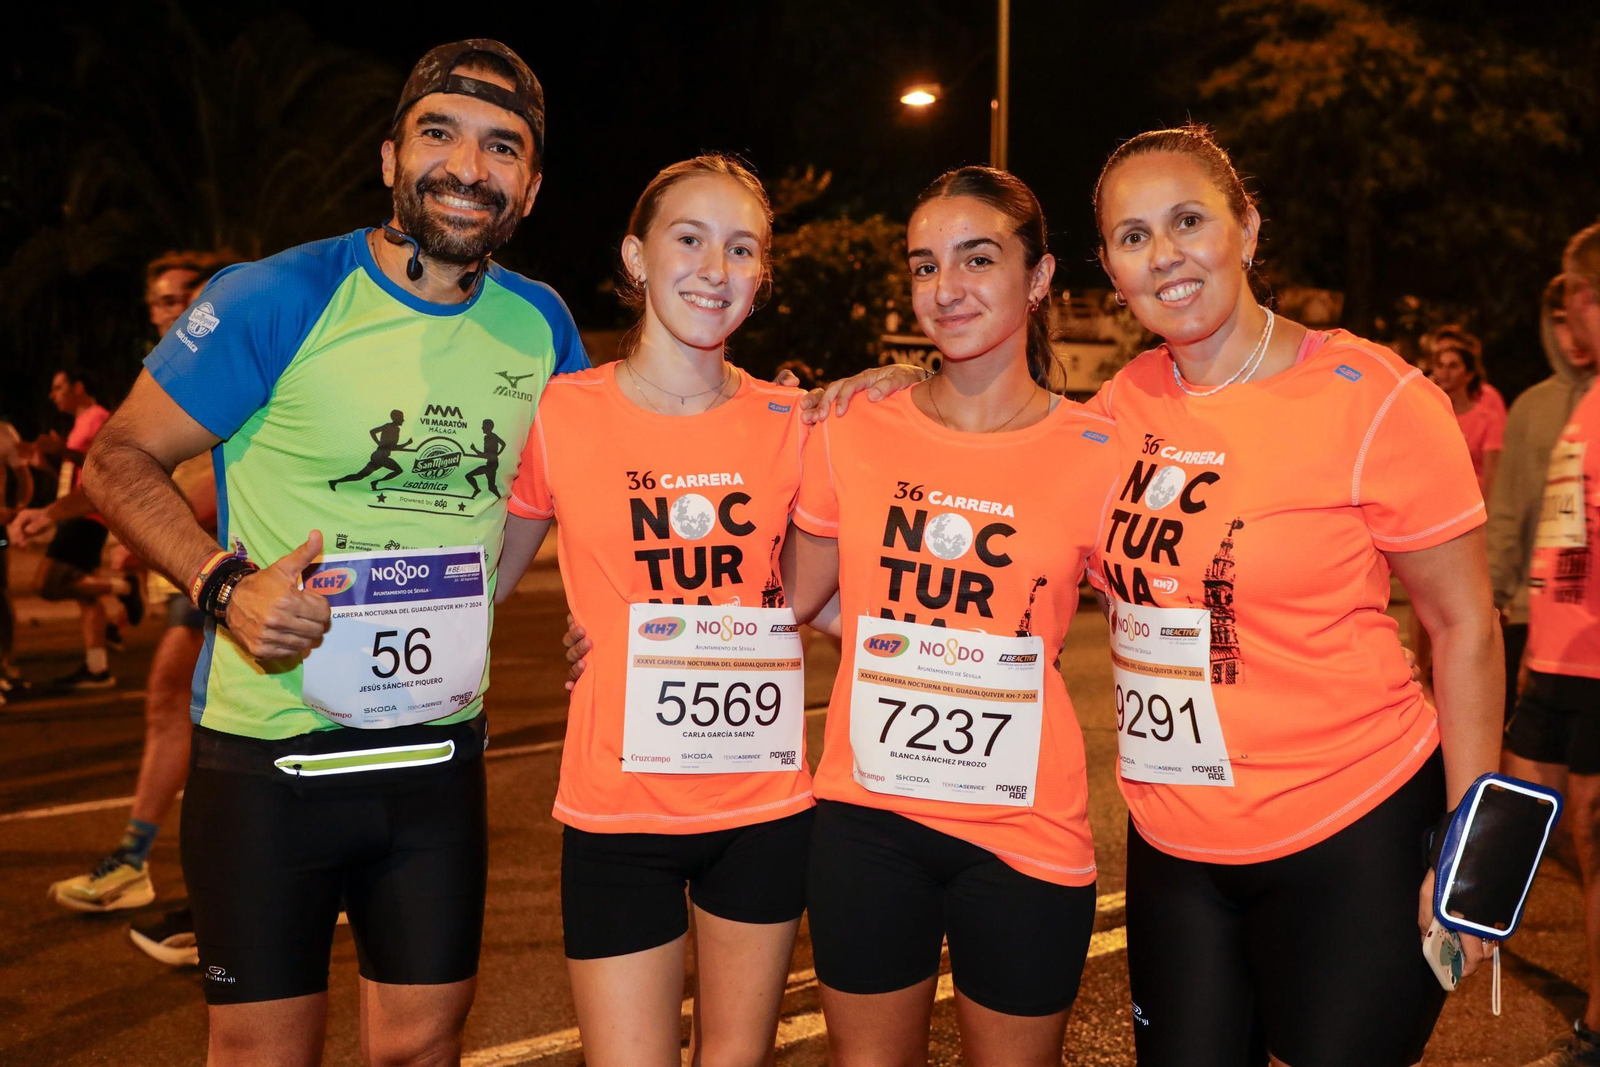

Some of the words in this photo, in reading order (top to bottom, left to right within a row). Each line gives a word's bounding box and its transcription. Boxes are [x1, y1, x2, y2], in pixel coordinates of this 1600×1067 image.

[493, 385, 533, 403] MIZUNO
[428, 427, 457, 435] MÁLAGA
[431, 418, 467, 429] MARATÓN
[1142, 433, 1165, 455] 36
[1160, 446, 1226, 466] CARRERA
[626, 471, 656, 490] 36
[660, 472, 744, 489] CARRERA
[894, 481, 924, 501] 36
[928, 490, 1015, 518] CARRERA
[1105, 508, 1184, 567] TUR
[634, 545, 744, 590] TUR
[880, 555, 994, 619] TUR
[332, 611, 363, 619] CARRERA
[364, 608, 398, 617] NOCTURNA
[410, 603, 454, 614] GUADALQUIVIR
[454, 602, 468, 610] KH-7
[371, 627, 432, 679] 56
[733, 661, 776, 669] GUADALQUIVIR
[1137, 664, 1174, 675] GUADALQUIVIR
[1174, 668, 1187, 676] KH-7
[359, 682, 381, 693] JESÚS
[382, 679, 414, 690] SÁNCHEZ
[415, 677, 443, 687] PIQUERO
[860, 672, 878, 680] XXXVI
[879, 675, 906, 685] CARRERA
[907, 680, 941, 691] NOCTURNA
[942, 684, 954, 693] DEL
[955, 687, 1005, 699] GUADALQUIVIR
[450, 691, 473, 704] POWER
[656, 680, 782, 727] 5569
[1116, 683, 1202, 744] 9291
[707, 730, 733, 738] GARCÍA
[878, 697, 1012, 757] 7237
[631, 754, 671, 764] Cruzcampo
[769, 751, 796, 759] POWER
[781, 757, 796, 766] ADE
[890, 751, 920, 762] BLANCA
[921, 754, 956, 766] SÁNCHEZ
[957, 759, 987, 768] PEROZO
[1191, 765, 1224, 773] POWER
[995, 784, 1027, 793] POWER
[1009, 791, 1027, 800] ADE
